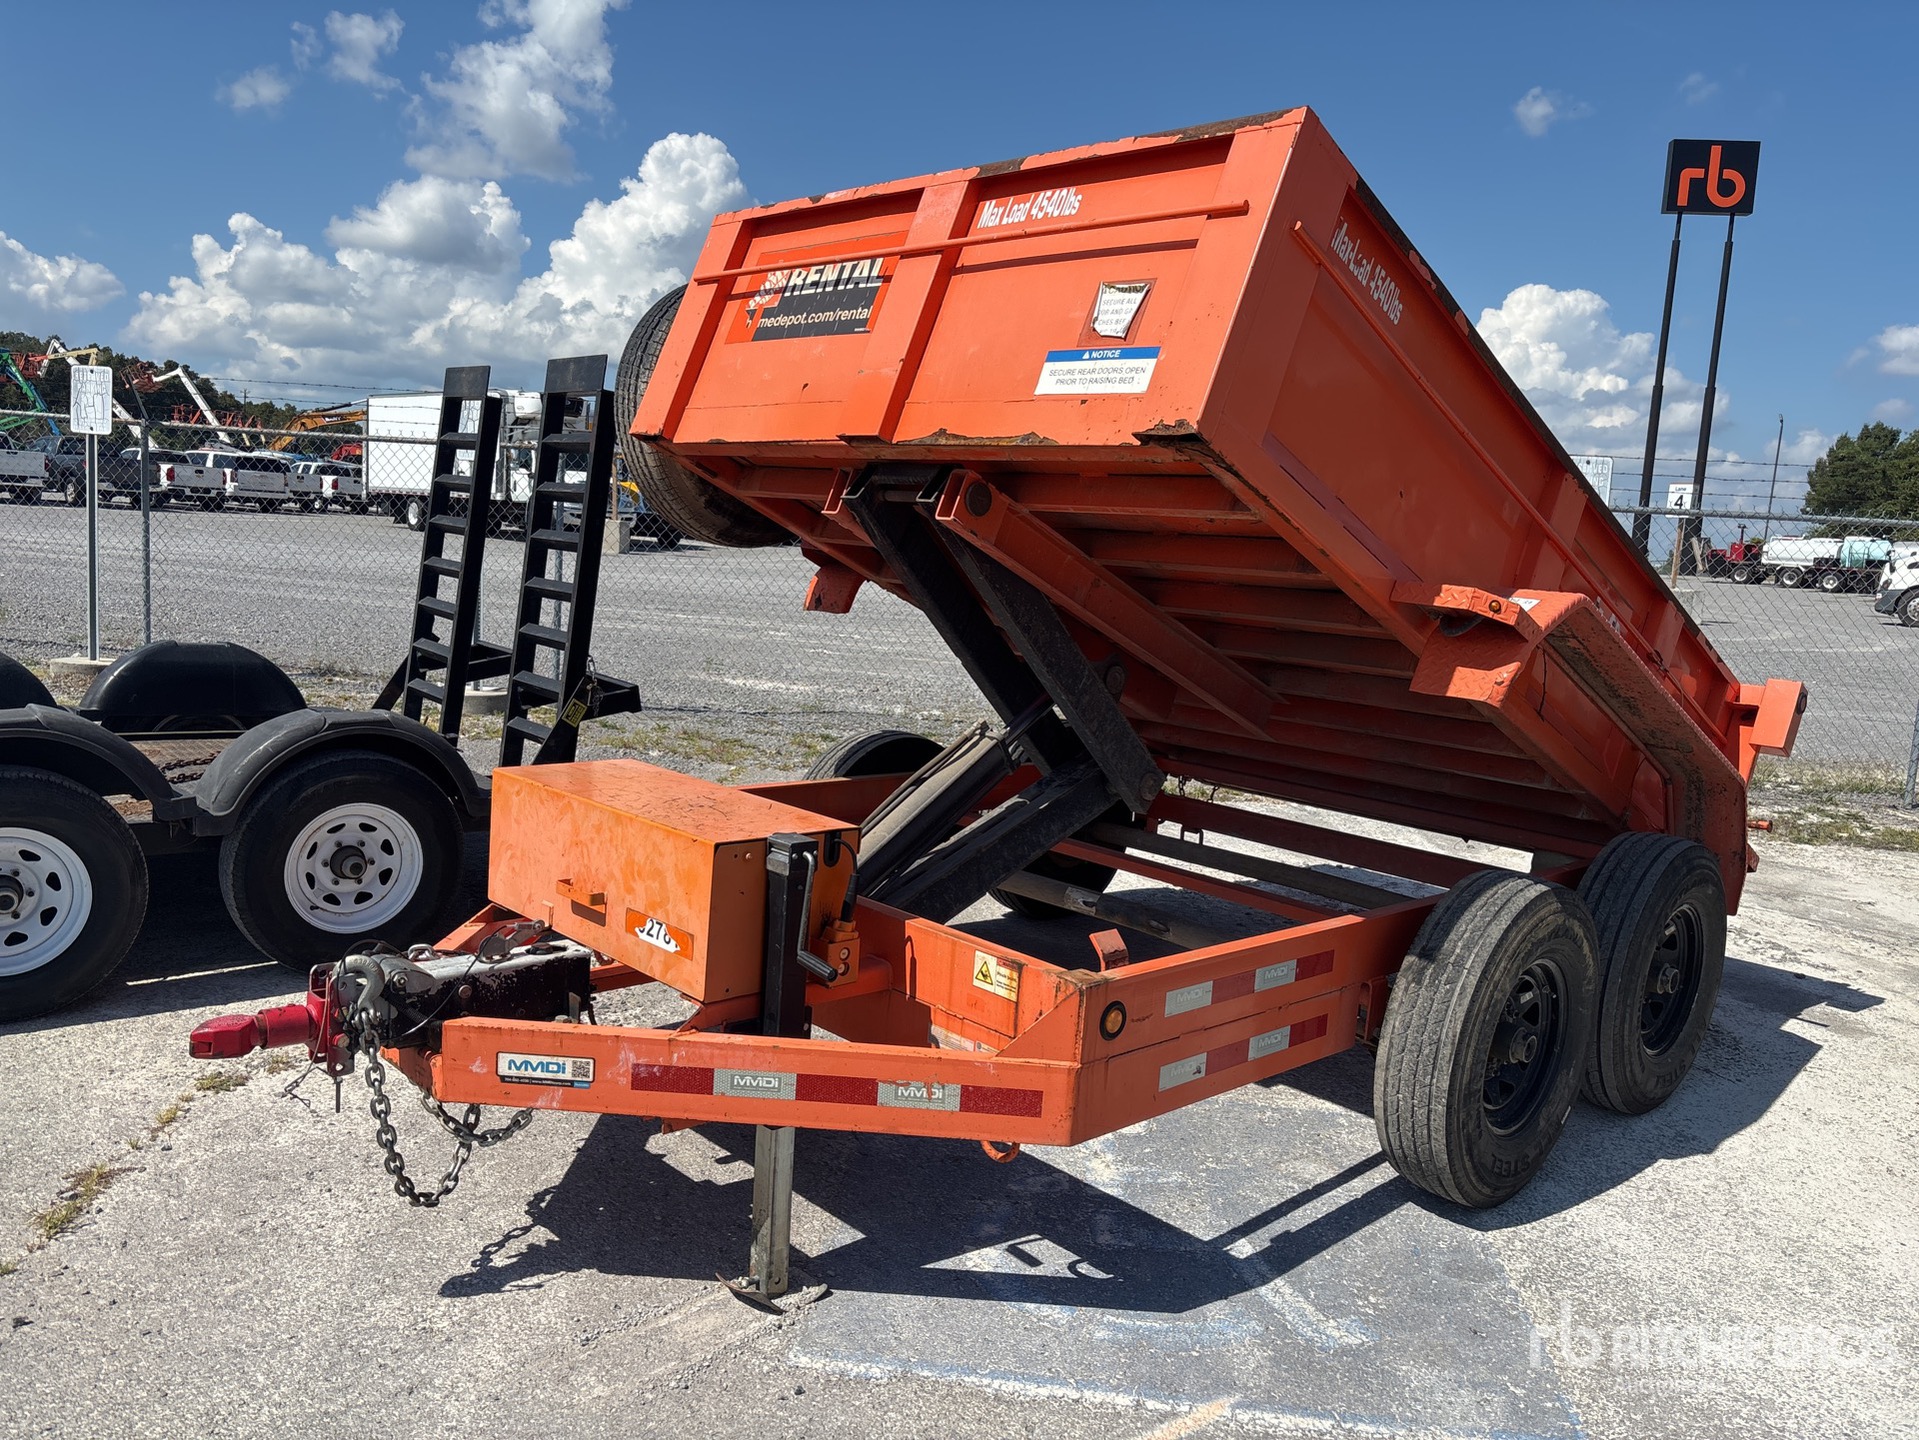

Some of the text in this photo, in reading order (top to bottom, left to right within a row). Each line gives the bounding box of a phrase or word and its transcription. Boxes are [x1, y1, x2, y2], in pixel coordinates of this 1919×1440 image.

[1677, 145, 1746, 208] rb
[977, 187, 1083, 229] Max Load 4540lbs
[784, 257, 884, 297] RENTAL
[1369, 264, 1403, 325] 4540lbs
[746, 305, 873, 329] hmedepot.com/rental
[1091, 349, 1121, 358] NOTICE
[1049, 366, 1147, 377] SECURE REAR DOORS OPEN
[1055, 378, 1077, 386] PRIOR
[1088, 376, 1117, 385] RAISING
[1118, 376, 1135, 384] BED
[1674, 494, 1684, 508] 4
